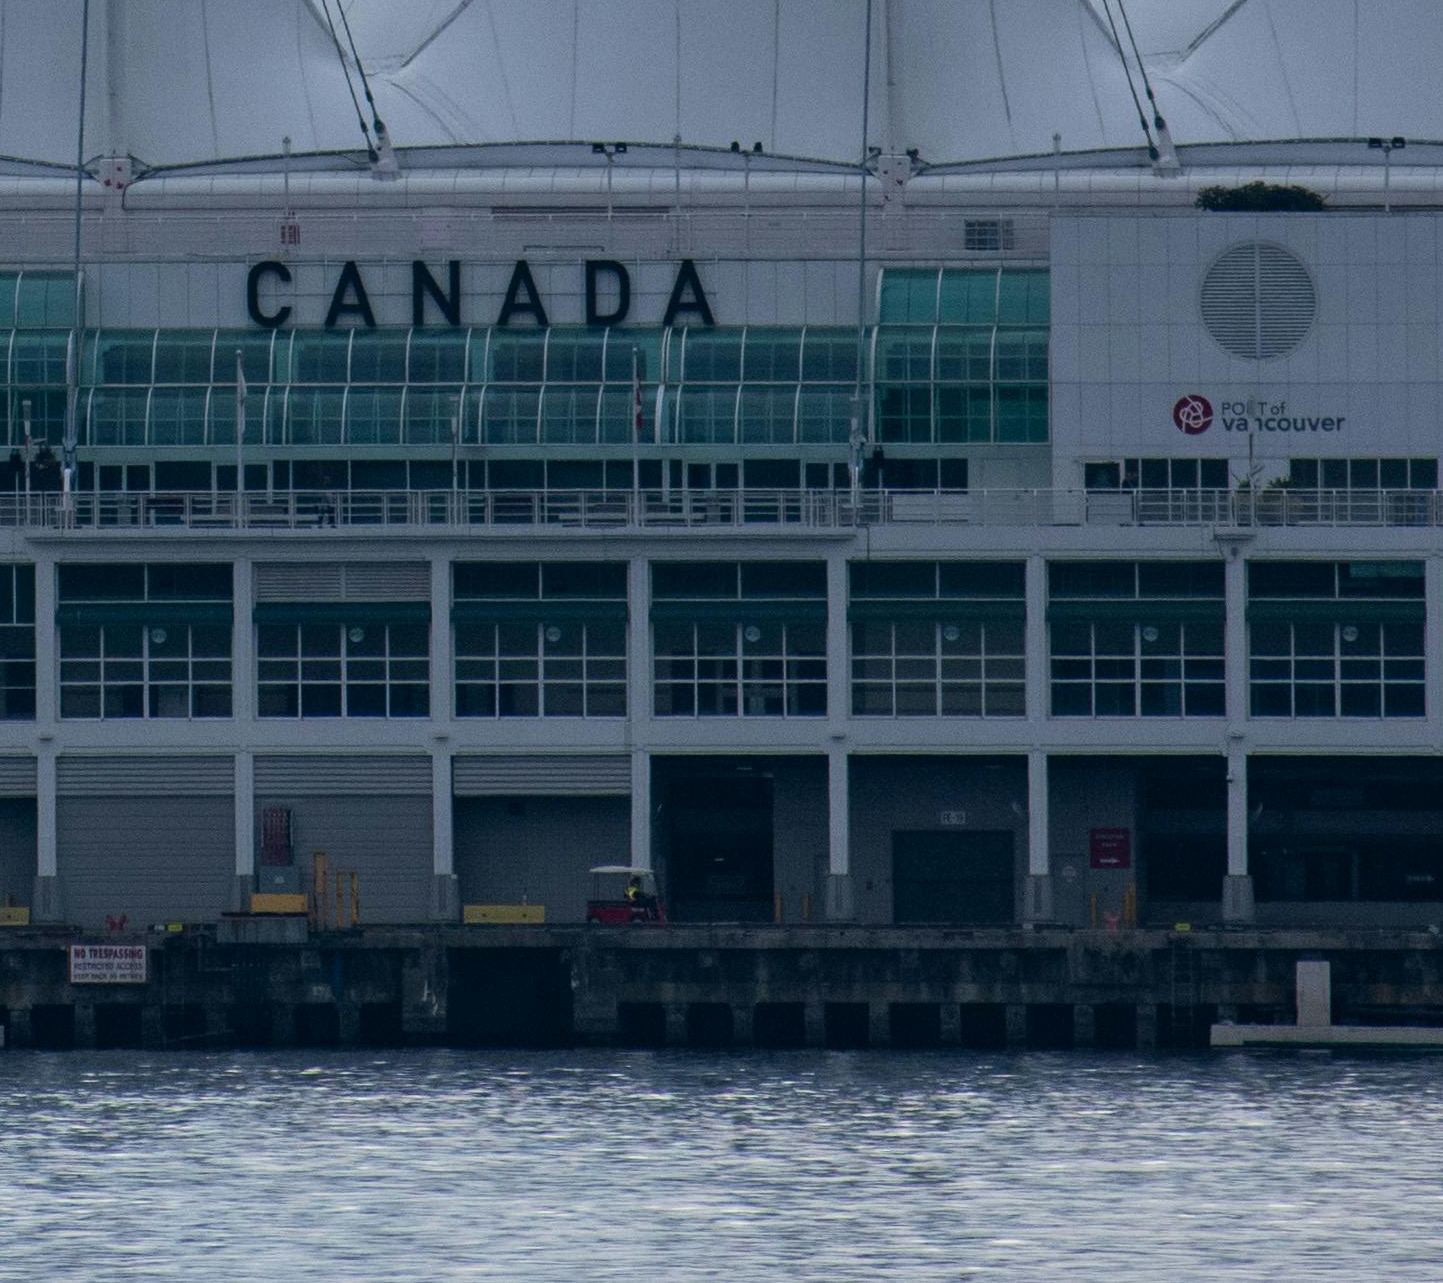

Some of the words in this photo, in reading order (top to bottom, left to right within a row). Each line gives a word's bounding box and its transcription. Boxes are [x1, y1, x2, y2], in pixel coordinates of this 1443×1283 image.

[246, 259, 716, 329] CANADA
[1221, 402, 1267, 416] POT
[1271, 401, 1287, 415] of
[74, 948, 86, 959] NO
[89, 948, 143, 959] TRESPASSING
